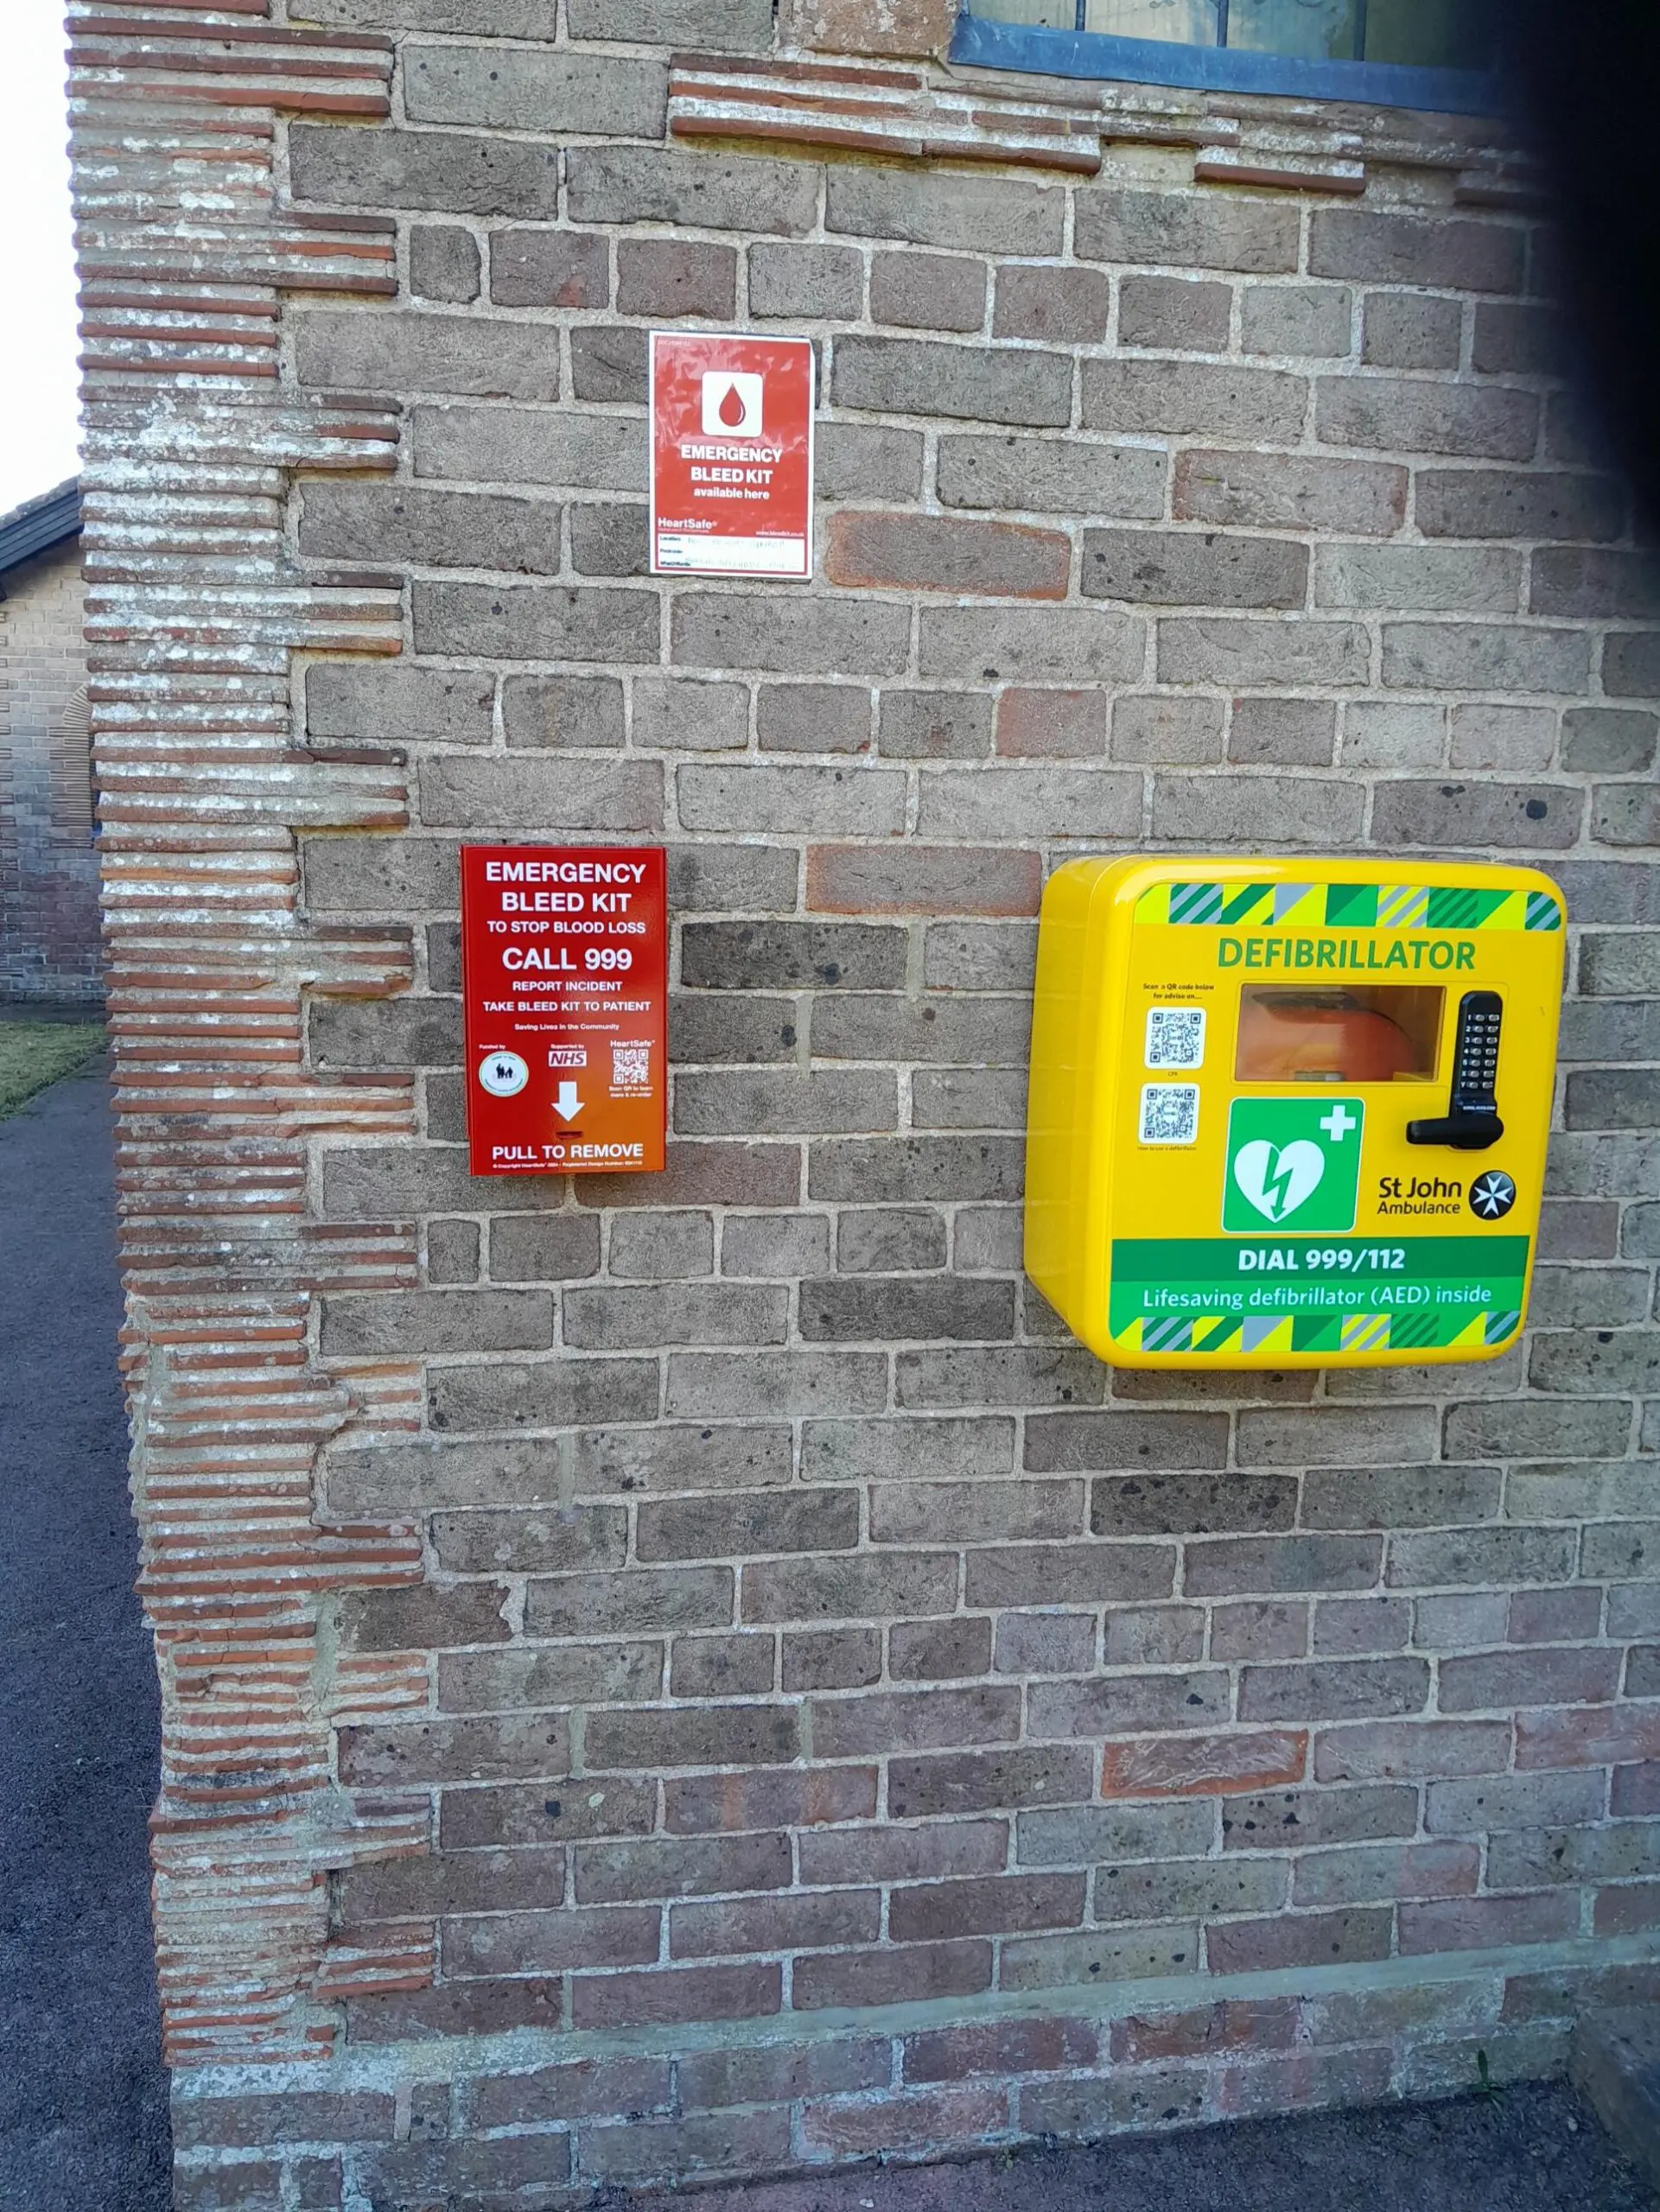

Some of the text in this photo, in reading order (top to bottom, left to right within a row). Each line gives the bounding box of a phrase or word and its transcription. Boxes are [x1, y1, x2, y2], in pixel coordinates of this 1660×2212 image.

[681, 444, 782, 463] EMERGENCY
[691, 467, 773, 484] BLEED KIT
[693, 486, 770, 499] available here
[486, 861, 646, 883] EMERGENCY
[501, 892, 632, 912] BLEED KIT
[487, 920, 646, 934] TO STOP BLOOD LOSS
[502, 947, 633, 970] CALL 999
[1218, 938, 1476, 970] DEFIBRILLATOR
[512, 982, 622, 991] REPORT INCIDENT
[483, 1001, 652, 1012] TAKE BLEED KIT TO PATIENT
[550, 1052, 585, 1065] NHS
[492, 1143, 644, 1160] PULL TO REMOVE
[1378, 1176, 1462, 1198] St John
[1377, 1200, 1460, 1215] Ambulance
[1238, 1248, 1405, 1273] DIAL 999/112
[1143, 1284, 1491, 1310] Lifesaving defibrillator (AED) inside
